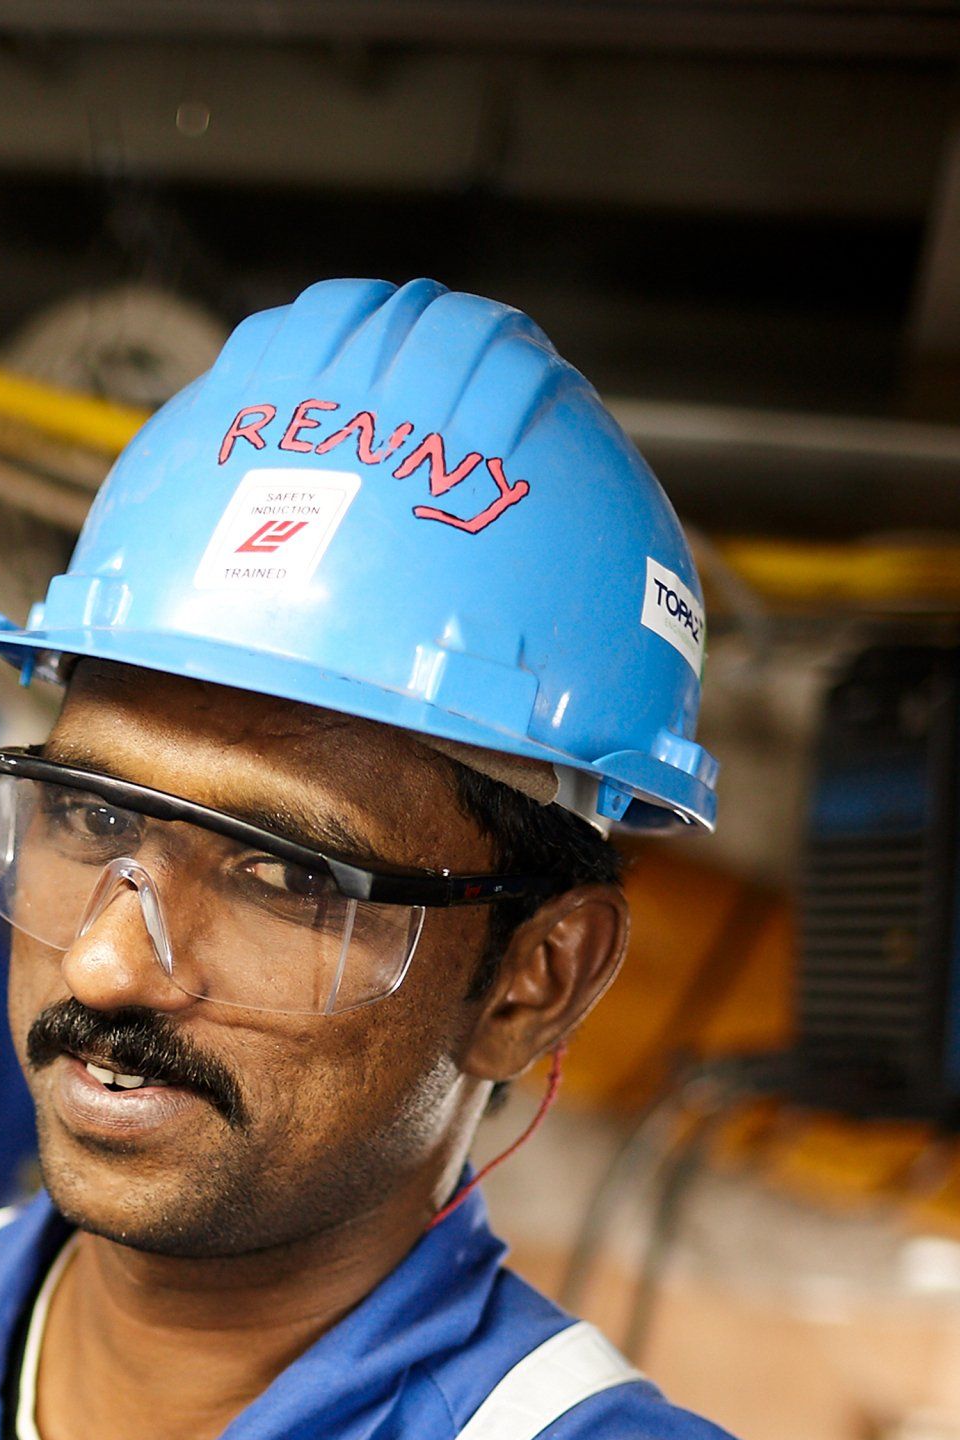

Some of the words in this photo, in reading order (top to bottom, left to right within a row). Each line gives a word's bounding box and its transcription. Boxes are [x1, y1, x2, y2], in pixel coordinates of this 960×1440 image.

[218, 398, 530, 535] RENNY
[266, 492, 316, 502] SAFETY
[250, 505, 321, 516] INDUCTION
[224, 567, 288, 580] TRAINED
